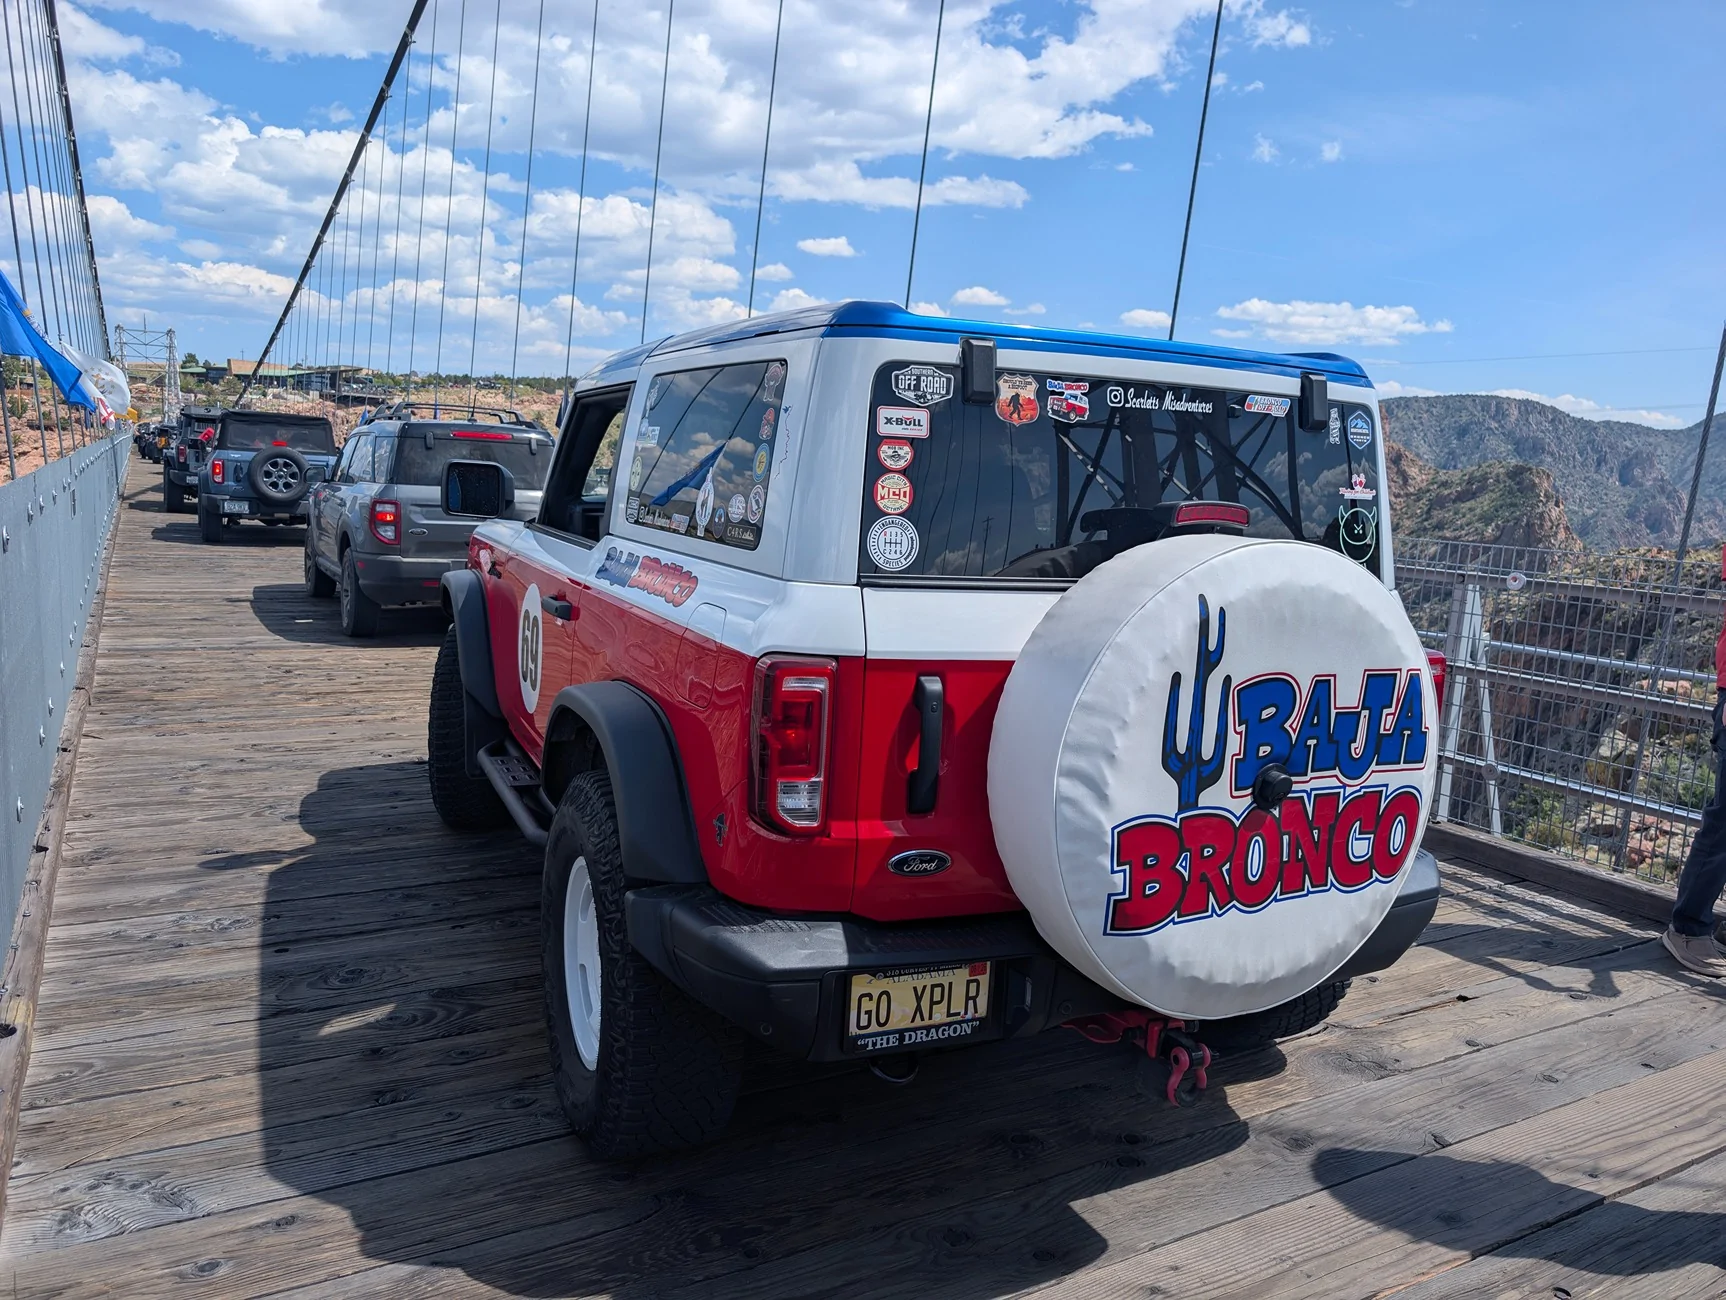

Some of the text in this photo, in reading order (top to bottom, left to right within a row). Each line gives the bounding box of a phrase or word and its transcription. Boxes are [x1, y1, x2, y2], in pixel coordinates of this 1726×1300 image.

[899, 375, 946, 394] OFF ROAD
[1125, 388, 1213, 413] Scarletts Misadventures
[884, 416, 923, 427] X-BULL
[882, 558, 903, 567] SPECIES
[521, 608, 540, 692] 69
[1232, 670, 1428, 796] BAJA
[903, 855, 937, 872] Ford
[1104, 785, 1422, 935] BRONCO
[910, 978, 981, 1023] XPLR
